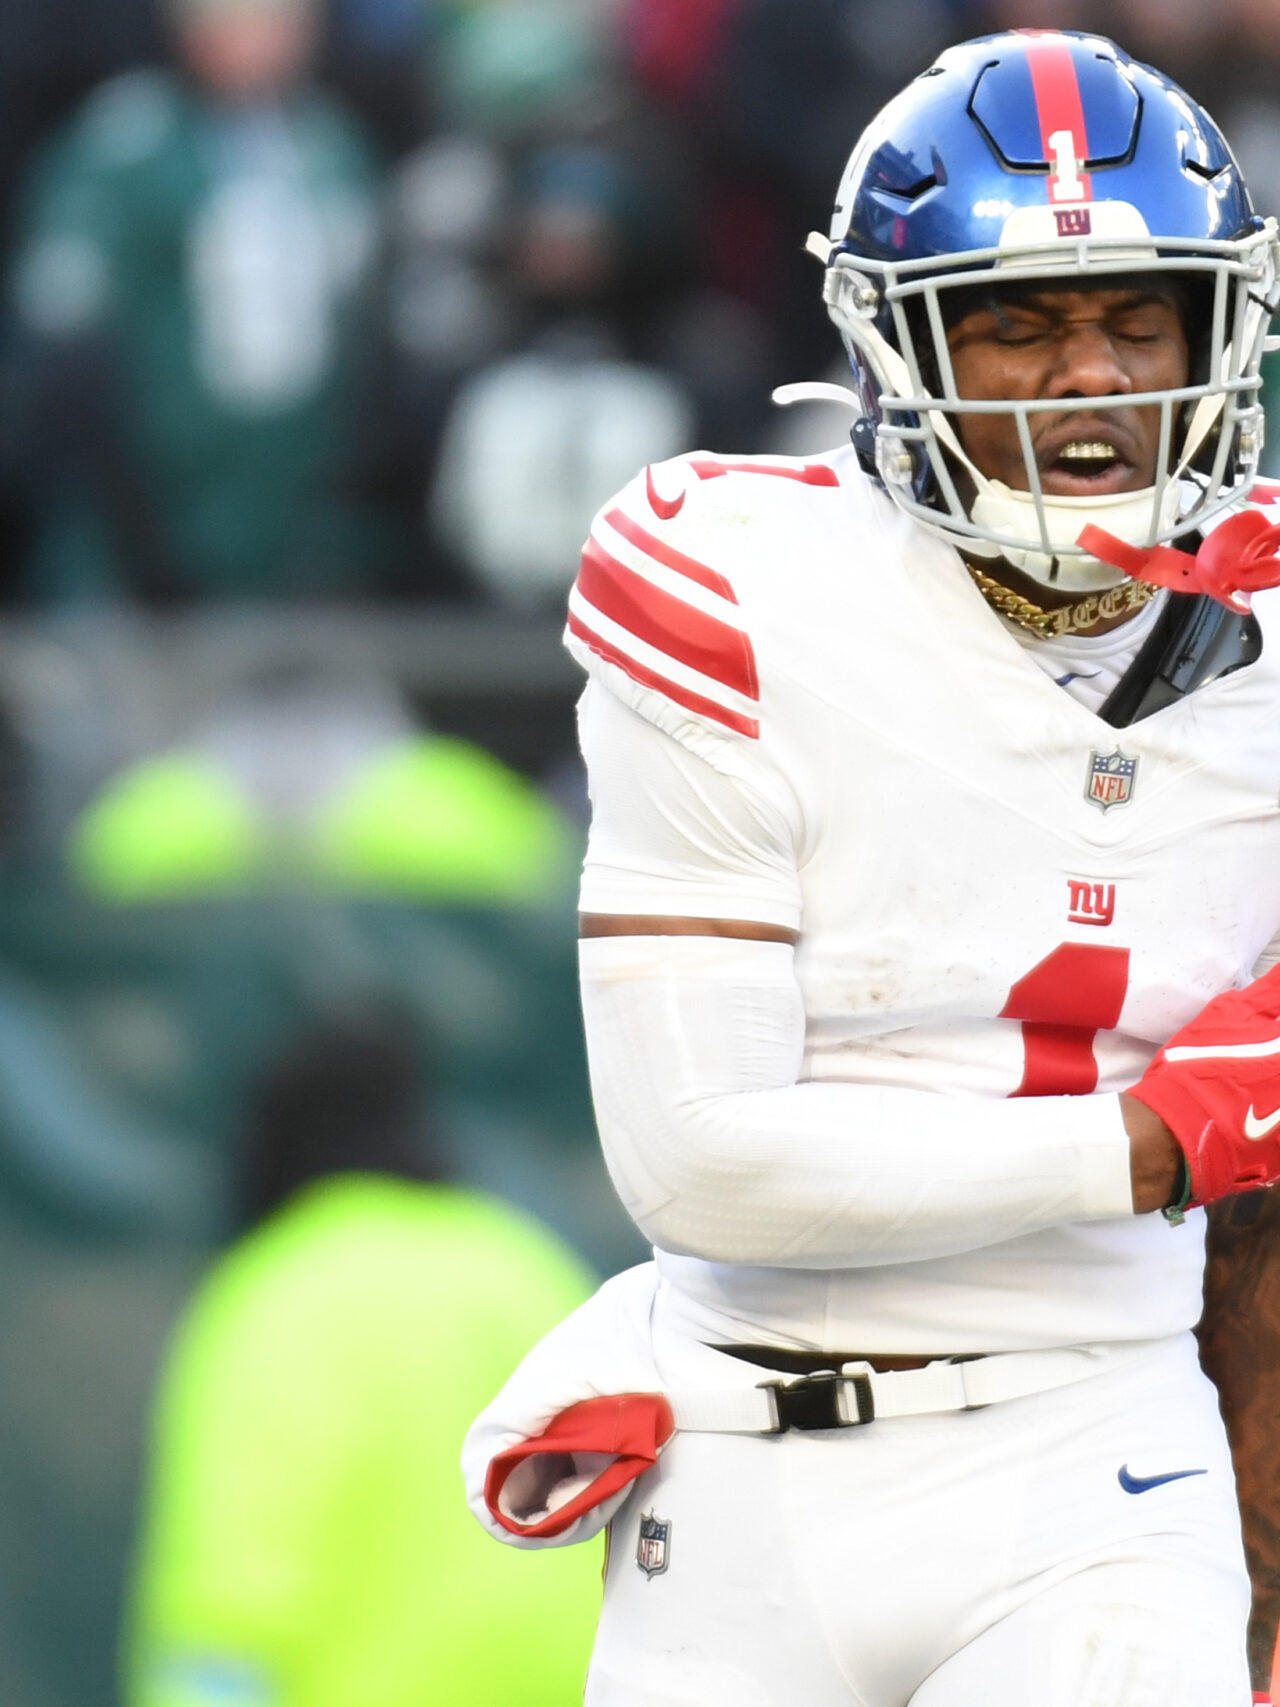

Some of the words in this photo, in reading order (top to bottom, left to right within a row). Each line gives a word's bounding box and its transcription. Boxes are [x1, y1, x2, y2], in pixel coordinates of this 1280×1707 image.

[1048, 130, 1085, 200] 1
[1092, 775, 1127, 802] NFL
[997, 941, 1131, 1098] 1
[639, 1540, 662, 1567] NFL
